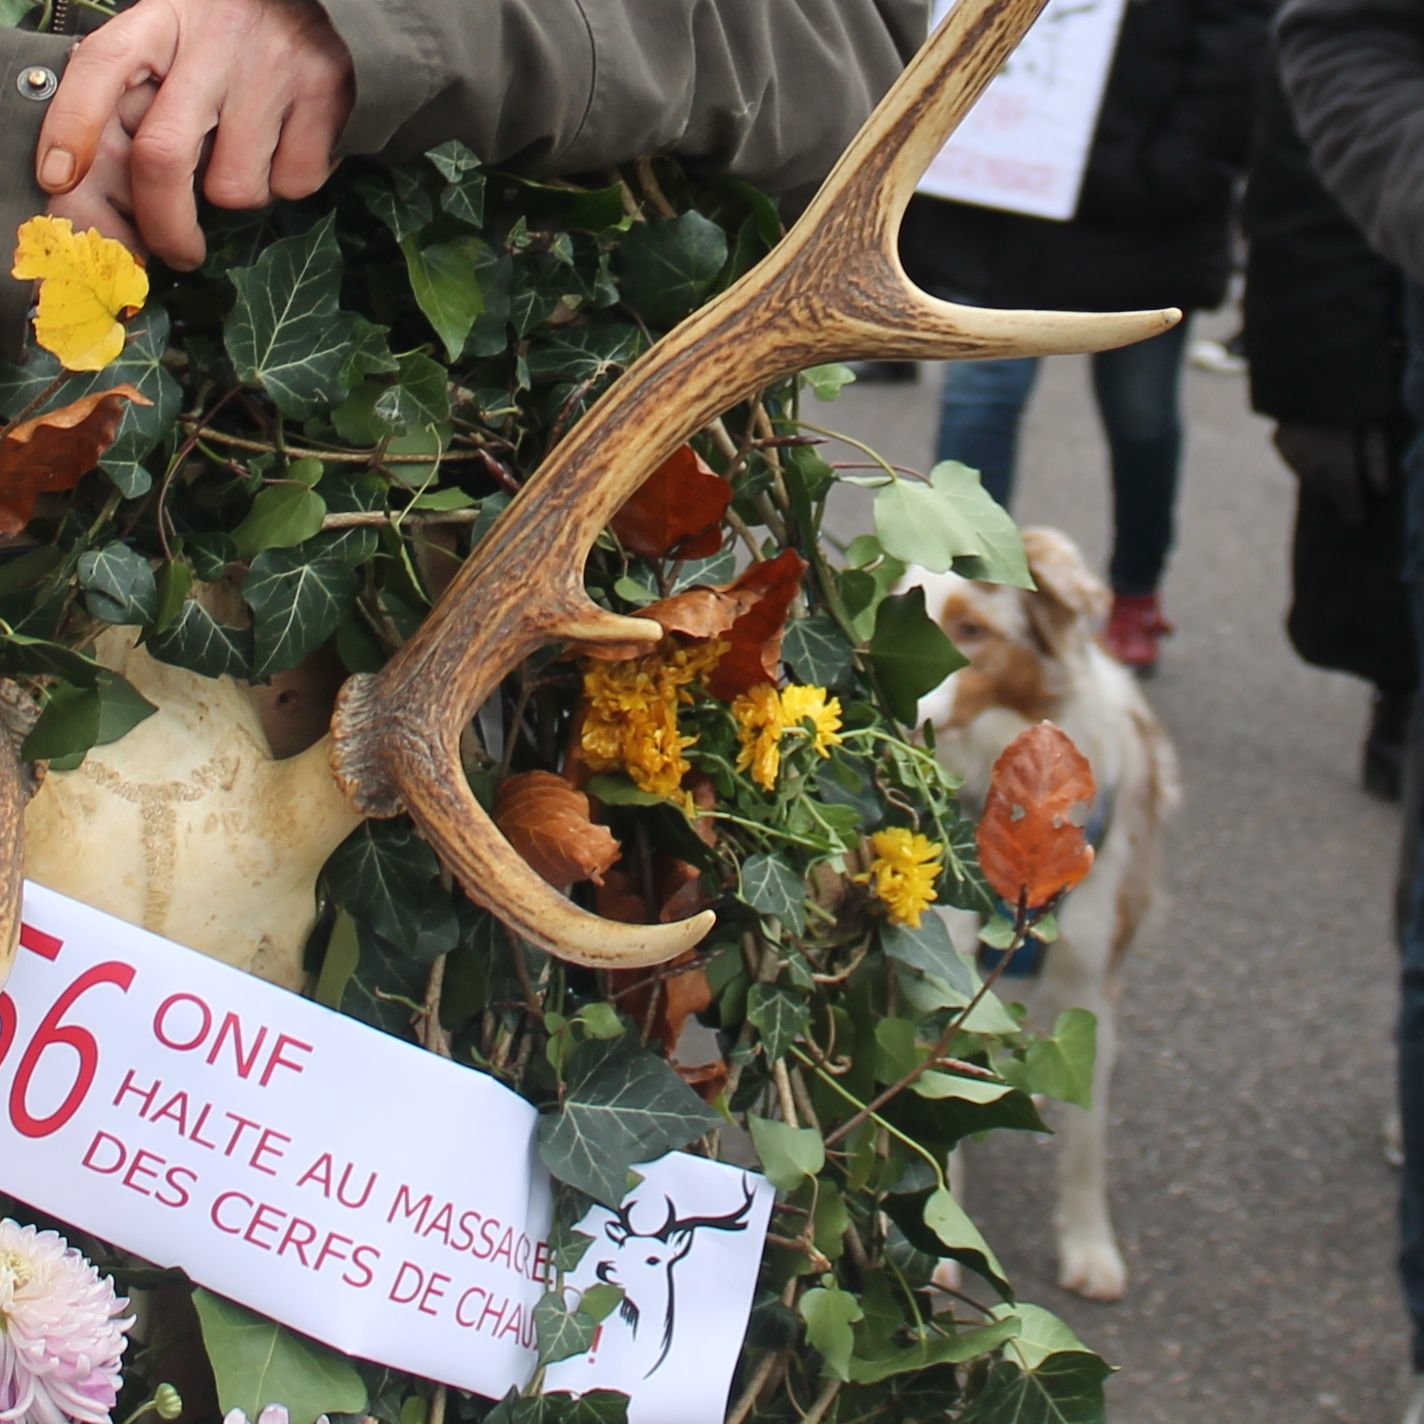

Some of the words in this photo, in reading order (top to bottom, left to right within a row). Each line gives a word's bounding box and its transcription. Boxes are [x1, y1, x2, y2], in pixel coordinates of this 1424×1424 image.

[153, 992, 314, 1087] ONF
[112, 1069, 292, 1177] HALTE
[296, 1152, 379, 1210] AU
[81, 1130, 198, 1208] DES
[210, 1191, 382, 1289] CERFS
[388, 1261, 452, 1316] DE
[455, 1287, 539, 1351] CHAU
